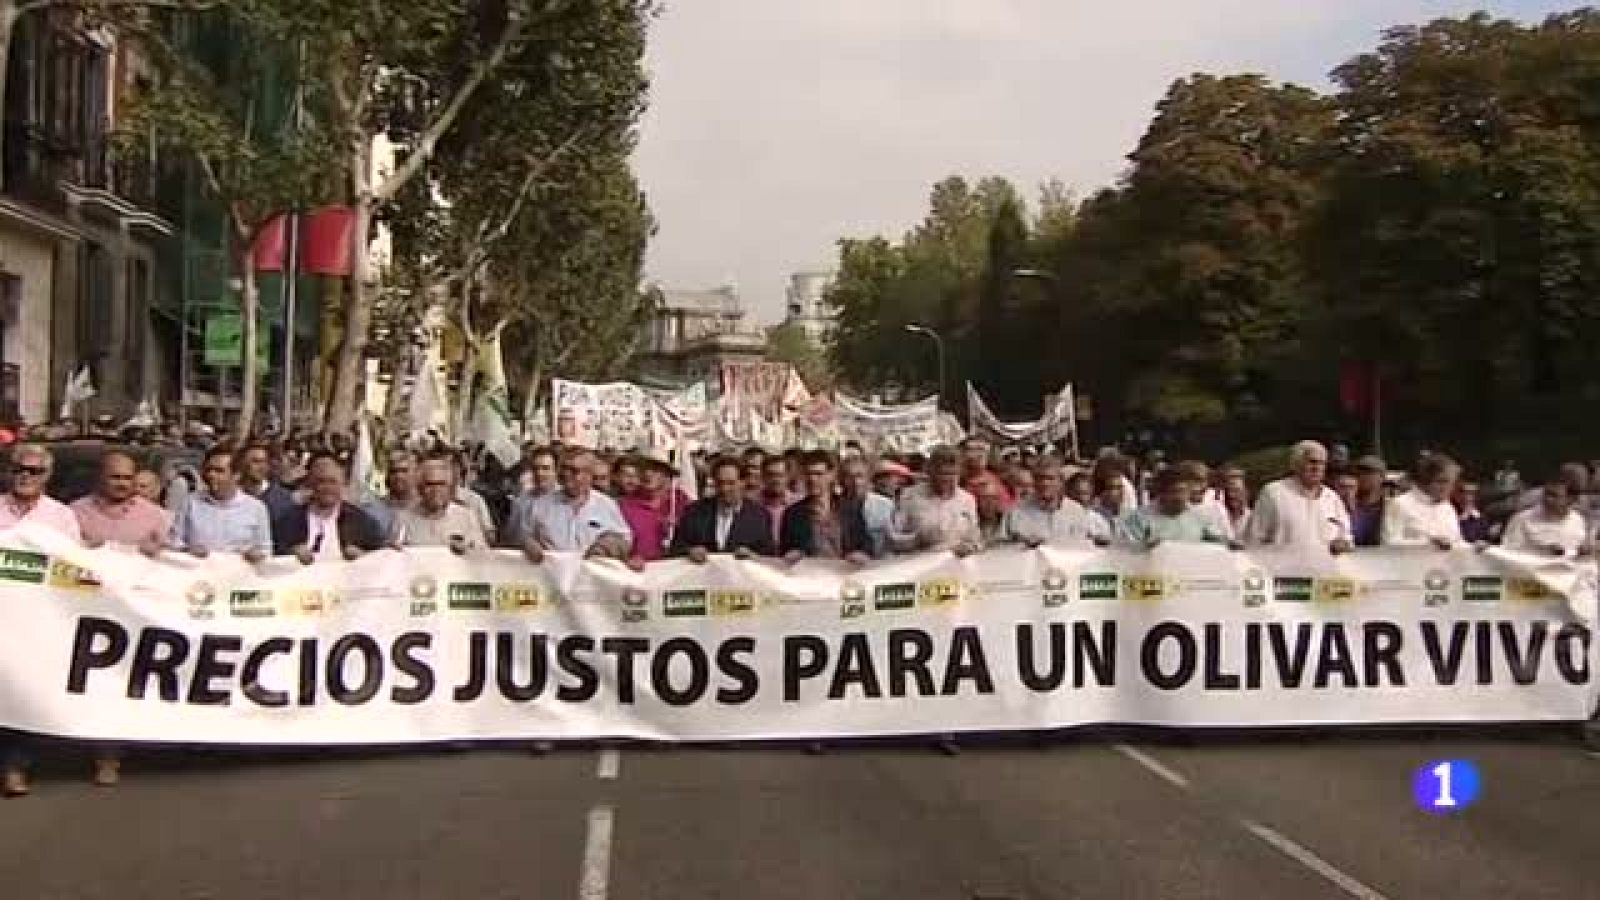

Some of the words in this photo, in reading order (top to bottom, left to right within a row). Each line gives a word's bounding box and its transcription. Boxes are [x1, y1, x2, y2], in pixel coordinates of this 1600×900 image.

[66, 616, 436, 708] PRECIOS
[453, 631, 759, 706] JUSTOS
[783, 626, 996, 703] PARA
[1016, 619, 1119, 693] UN
[1139, 621, 1406, 691] OLIVAR
[1419, 619, 1591, 686] VIVO
